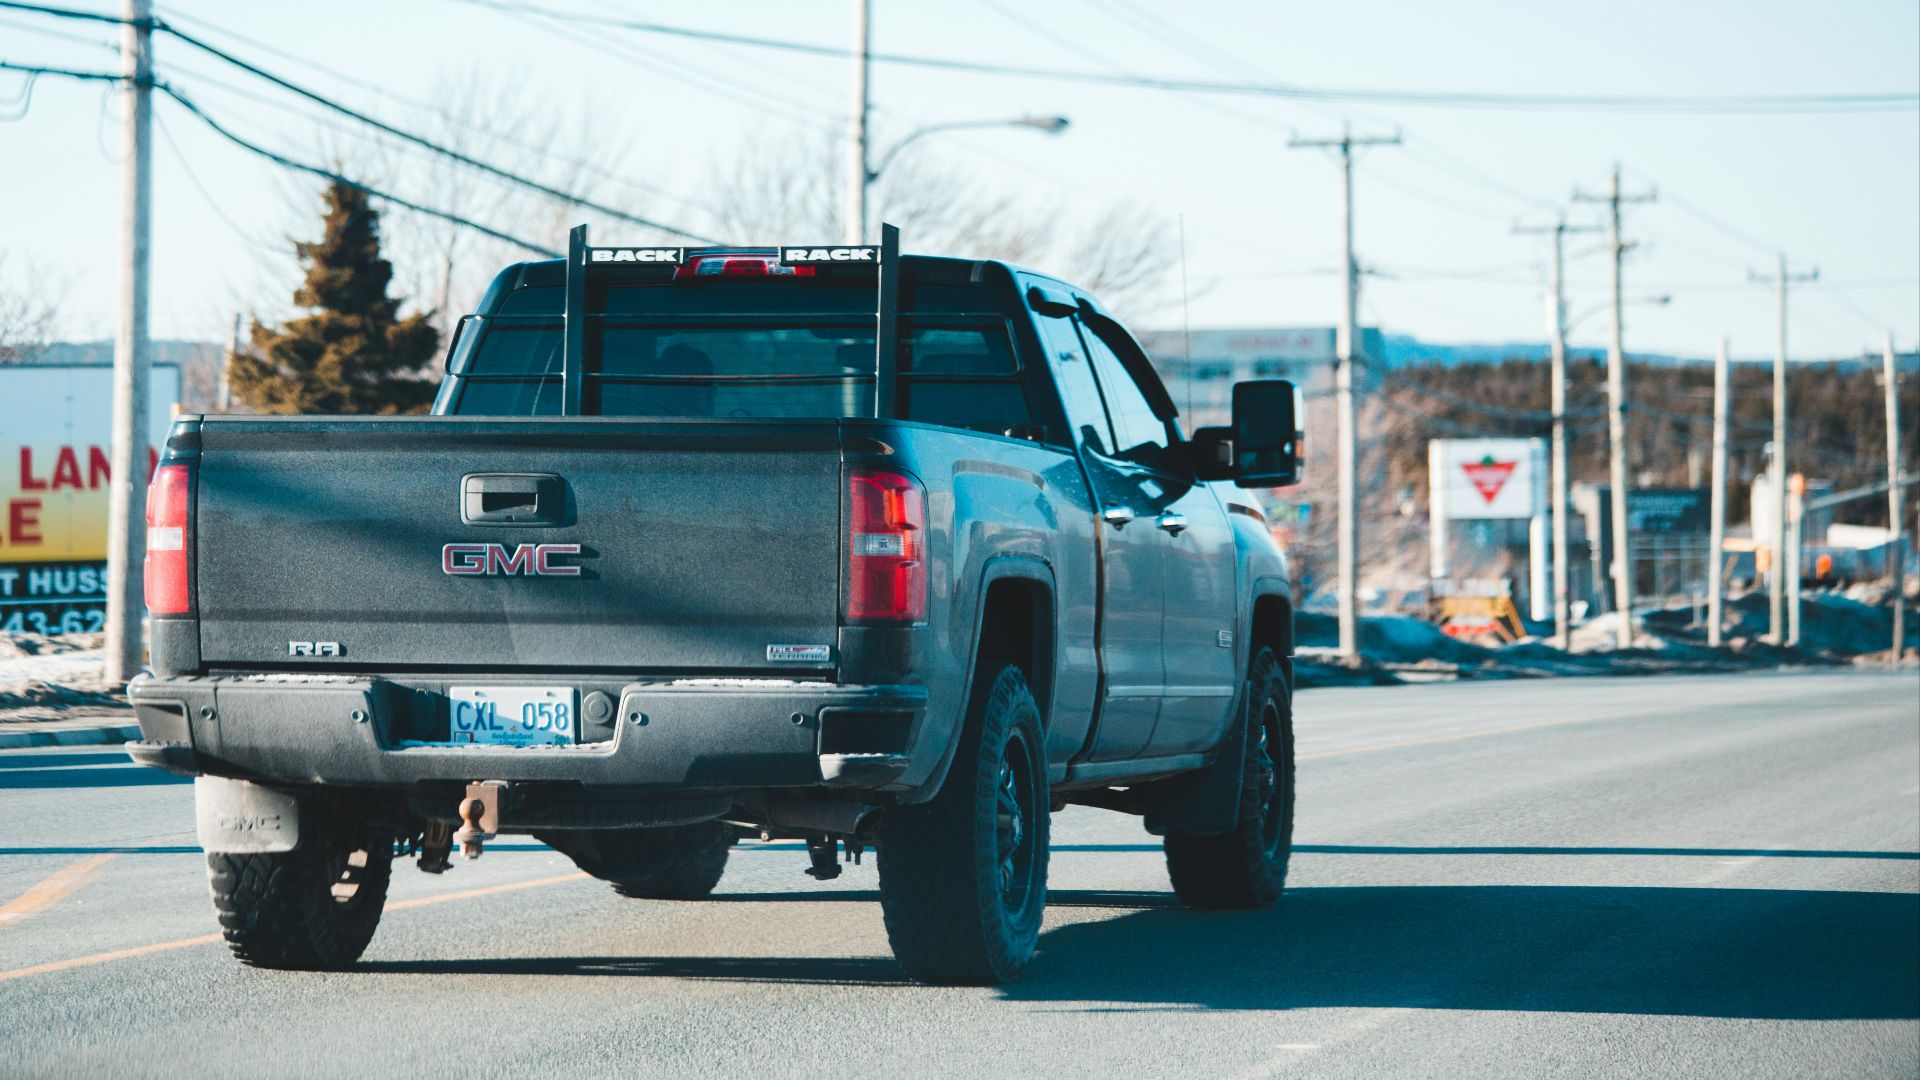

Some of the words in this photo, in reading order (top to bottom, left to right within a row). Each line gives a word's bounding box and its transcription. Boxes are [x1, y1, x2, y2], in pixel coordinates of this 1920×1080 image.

[591, 249, 677, 262] BACK
[785, 248, 874, 261] RACK
[19, 444, 158, 491] LAN
[442, 543, 581, 576] GMC
[288, 640, 340, 656] RA
[456, 701, 504, 731] CXL
[522, 702, 569, 731] 058
